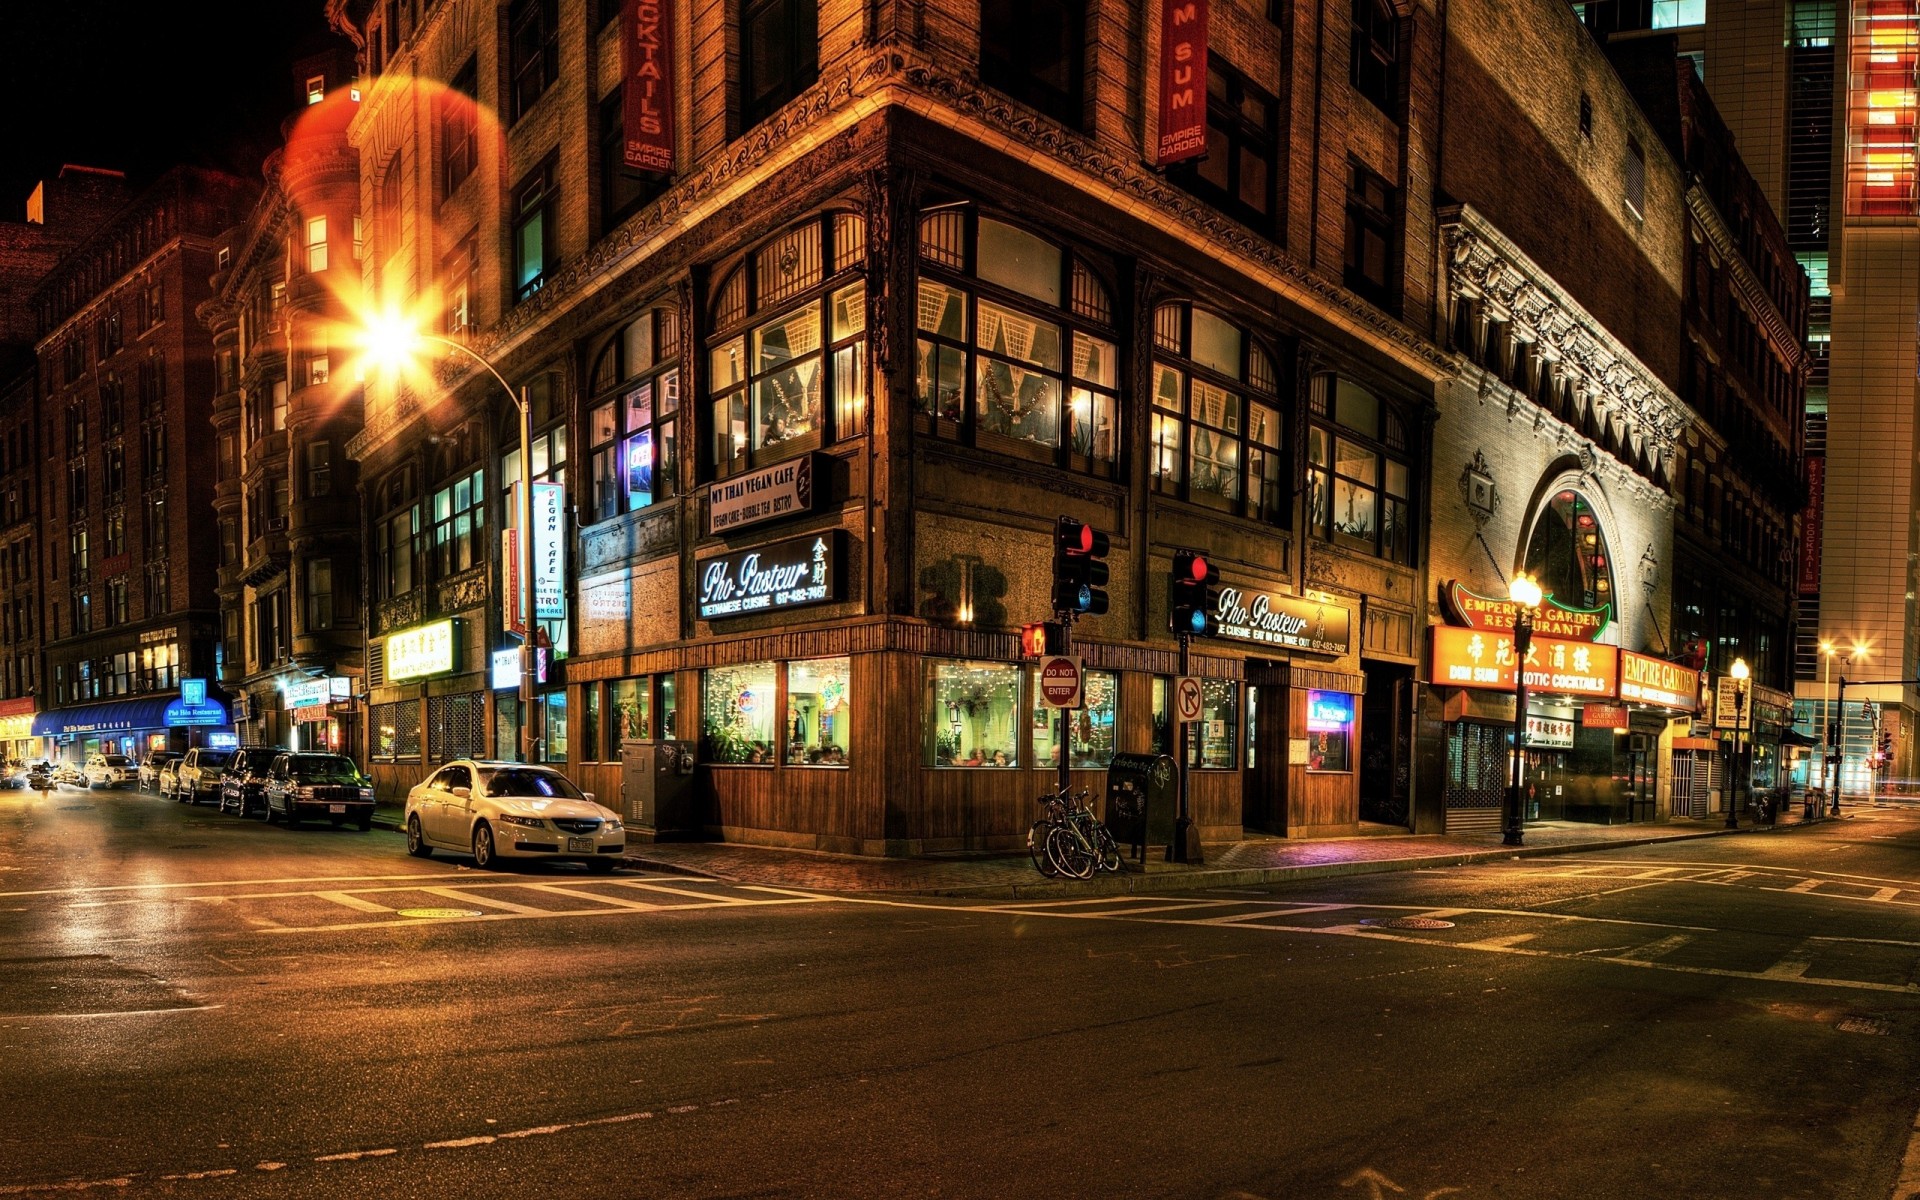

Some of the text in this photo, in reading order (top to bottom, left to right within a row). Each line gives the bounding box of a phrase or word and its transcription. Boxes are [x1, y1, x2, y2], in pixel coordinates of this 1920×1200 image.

[637, 0, 661, 135] CKTAILS
[1172, 42, 1193, 110] SUM
[1158, 135, 1204, 158] GARDEN
[1161, 125, 1202, 146] EMPIRE
[625, 151, 675, 170] GARDEN
[628, 141, 672, 159] EMPIRE
[711, 466, 794, 505] MY THAI VEGAN CAFE
[713, 514, 728, 528] VEGAN
[773, 495, 792, 512] BISTRO
[547, 490, 556, 574] VEGAN CAFE
[701, 553, 809, 603] Pho Pasteur
[702, 600, 741, 617] VIETNAMESE
[1215, 588, 1307, 635] Pho Pasteur
[1545, 610, 1600, 627] GARDEN
[1484, 614, 1584, 636] RESURANT
[1299, 637, 1310, 647] OUT
[1059, 668, 1074, 677] NOT
[1449, 665, 1472, 680] DIM
[1474, 667, 1499, 683] SUM
[1552, 673, 1605, 691] COCKTAILS
[1624, 654, 1697, 693] EMPIRE GARDEN
